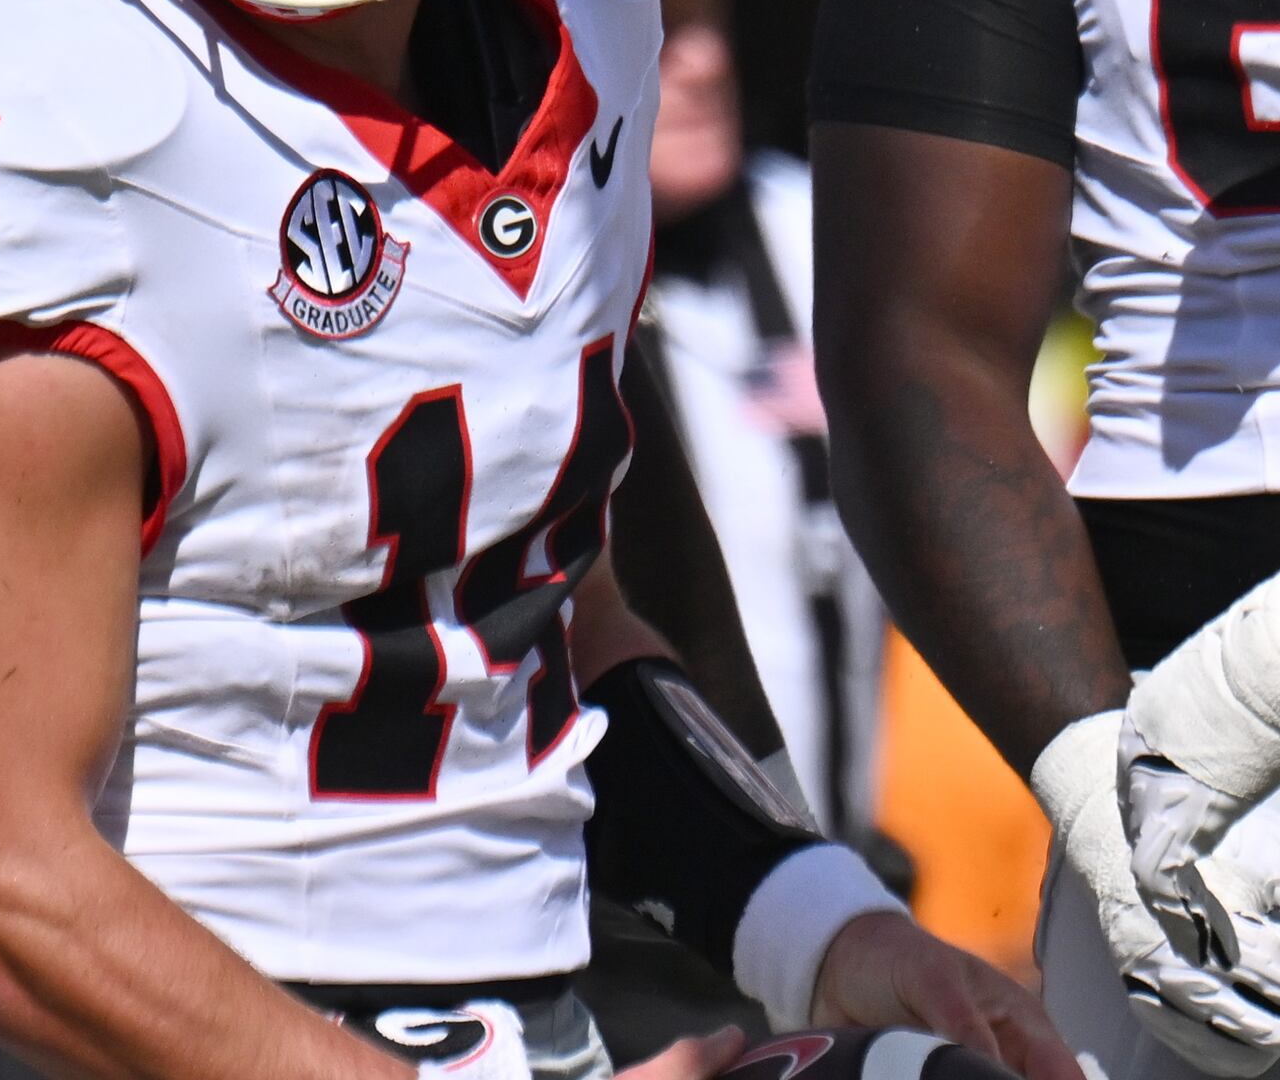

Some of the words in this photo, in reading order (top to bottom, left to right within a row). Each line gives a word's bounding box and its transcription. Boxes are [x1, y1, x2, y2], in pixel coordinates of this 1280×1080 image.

[286, 177, 376, 297] SEC
[480, 196, 537, 255] G
[292, 270, 396, 334] GRADUATE
[307, 331, 636, 803] 14
